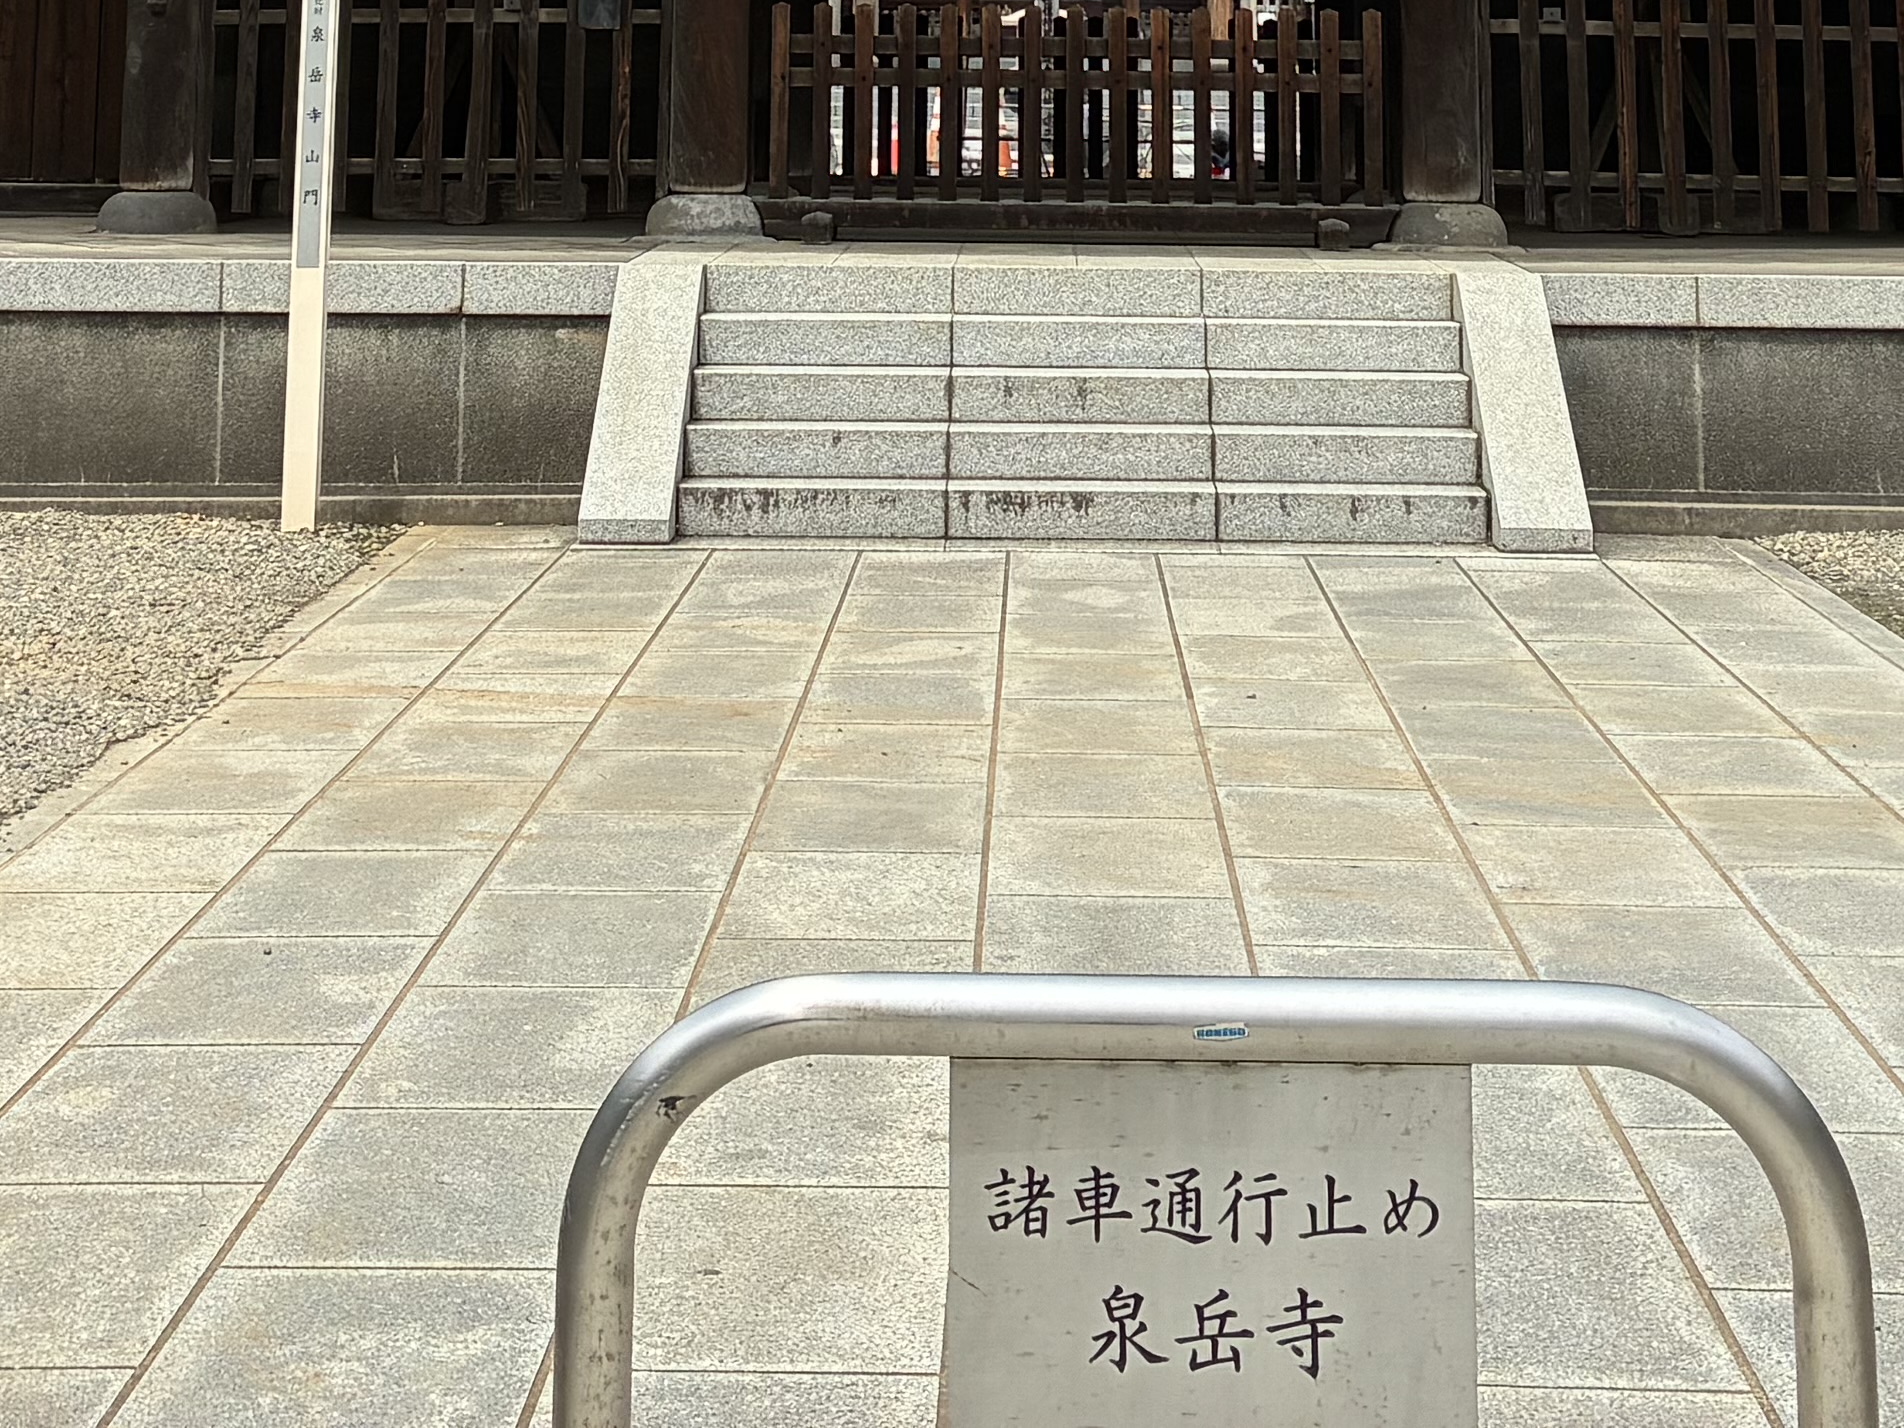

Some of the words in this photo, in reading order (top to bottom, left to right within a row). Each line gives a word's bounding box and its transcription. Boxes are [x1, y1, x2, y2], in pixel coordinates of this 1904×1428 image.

[302, 25, 325, 207] 泉岳寺山門
[983, 1164, 1441, 1247] 諸車通行止め
[1088, 1283, 1345, 1381] 泉岳寺
